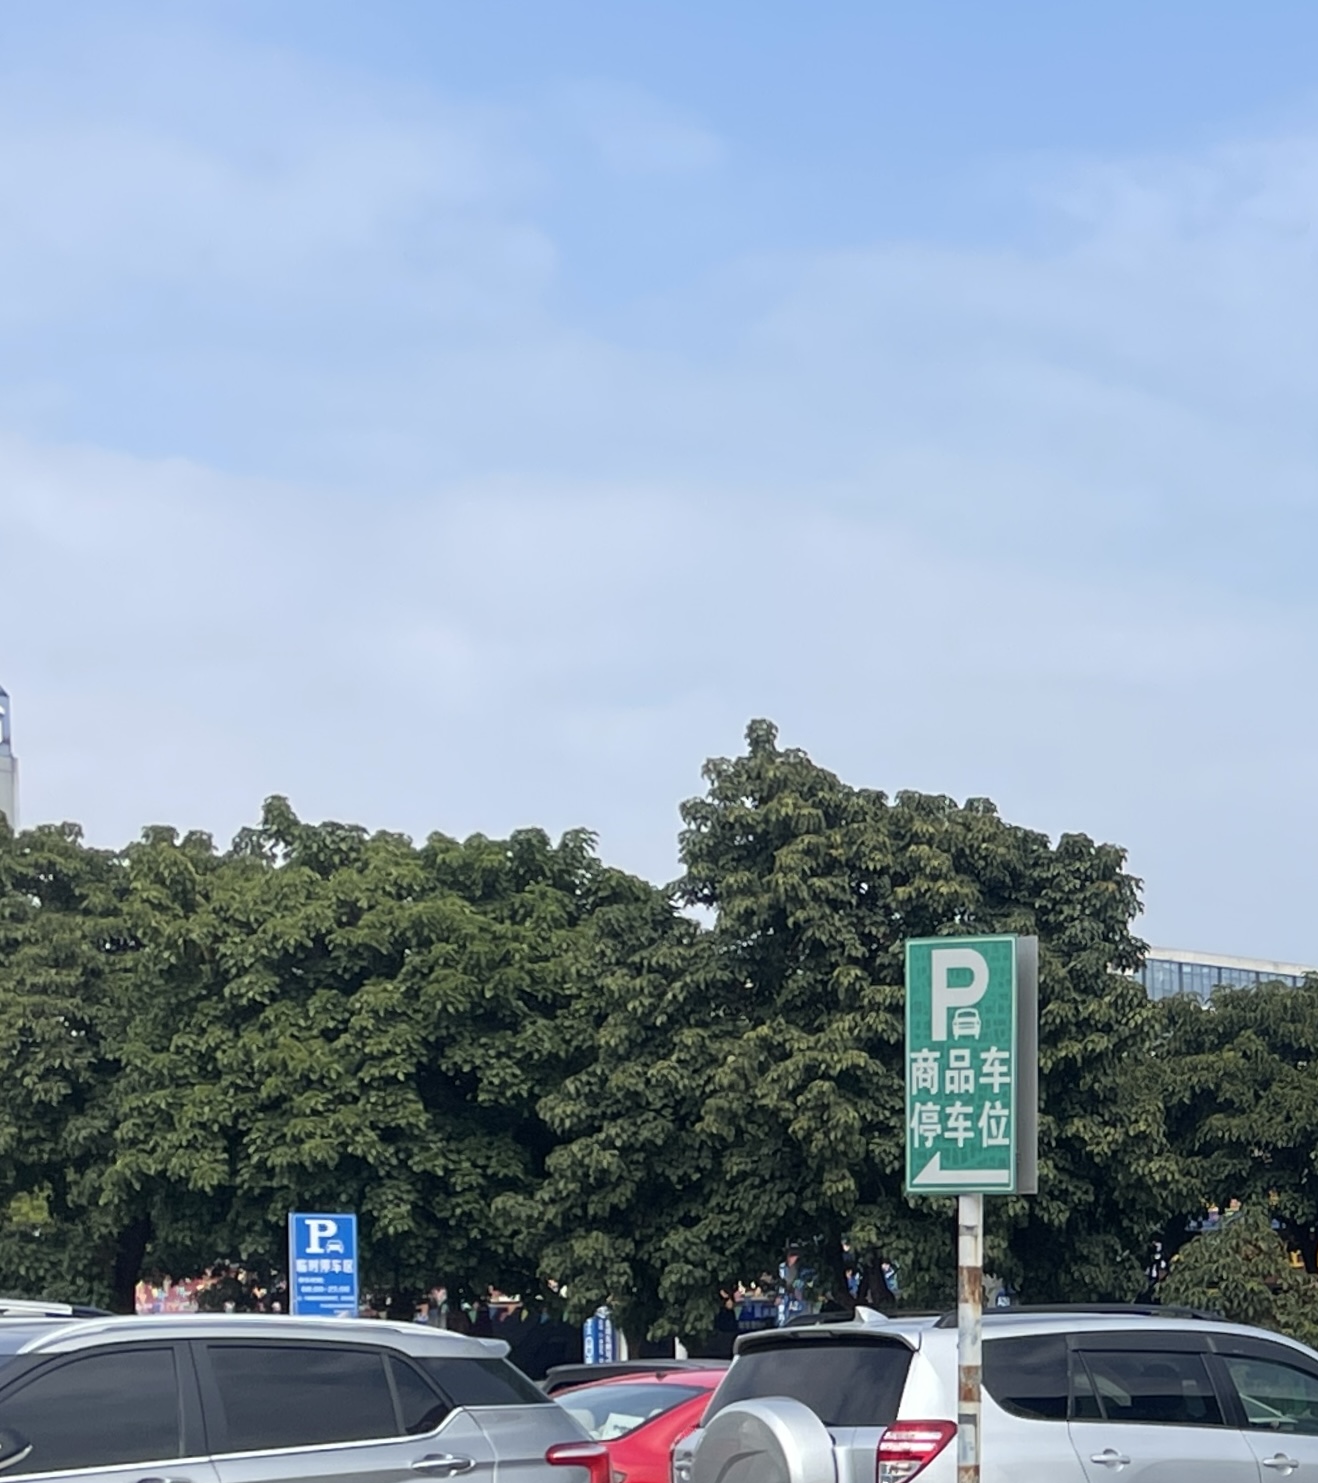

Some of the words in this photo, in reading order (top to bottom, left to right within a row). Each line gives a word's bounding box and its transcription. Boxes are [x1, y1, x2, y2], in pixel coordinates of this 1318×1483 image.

[931, 948, 990, 1041] P
[910, 1046, 1011, 1096] 商品车
[910, 1101, 1011, 1148] 停车位
[304, 1219, 338, 1254] P
